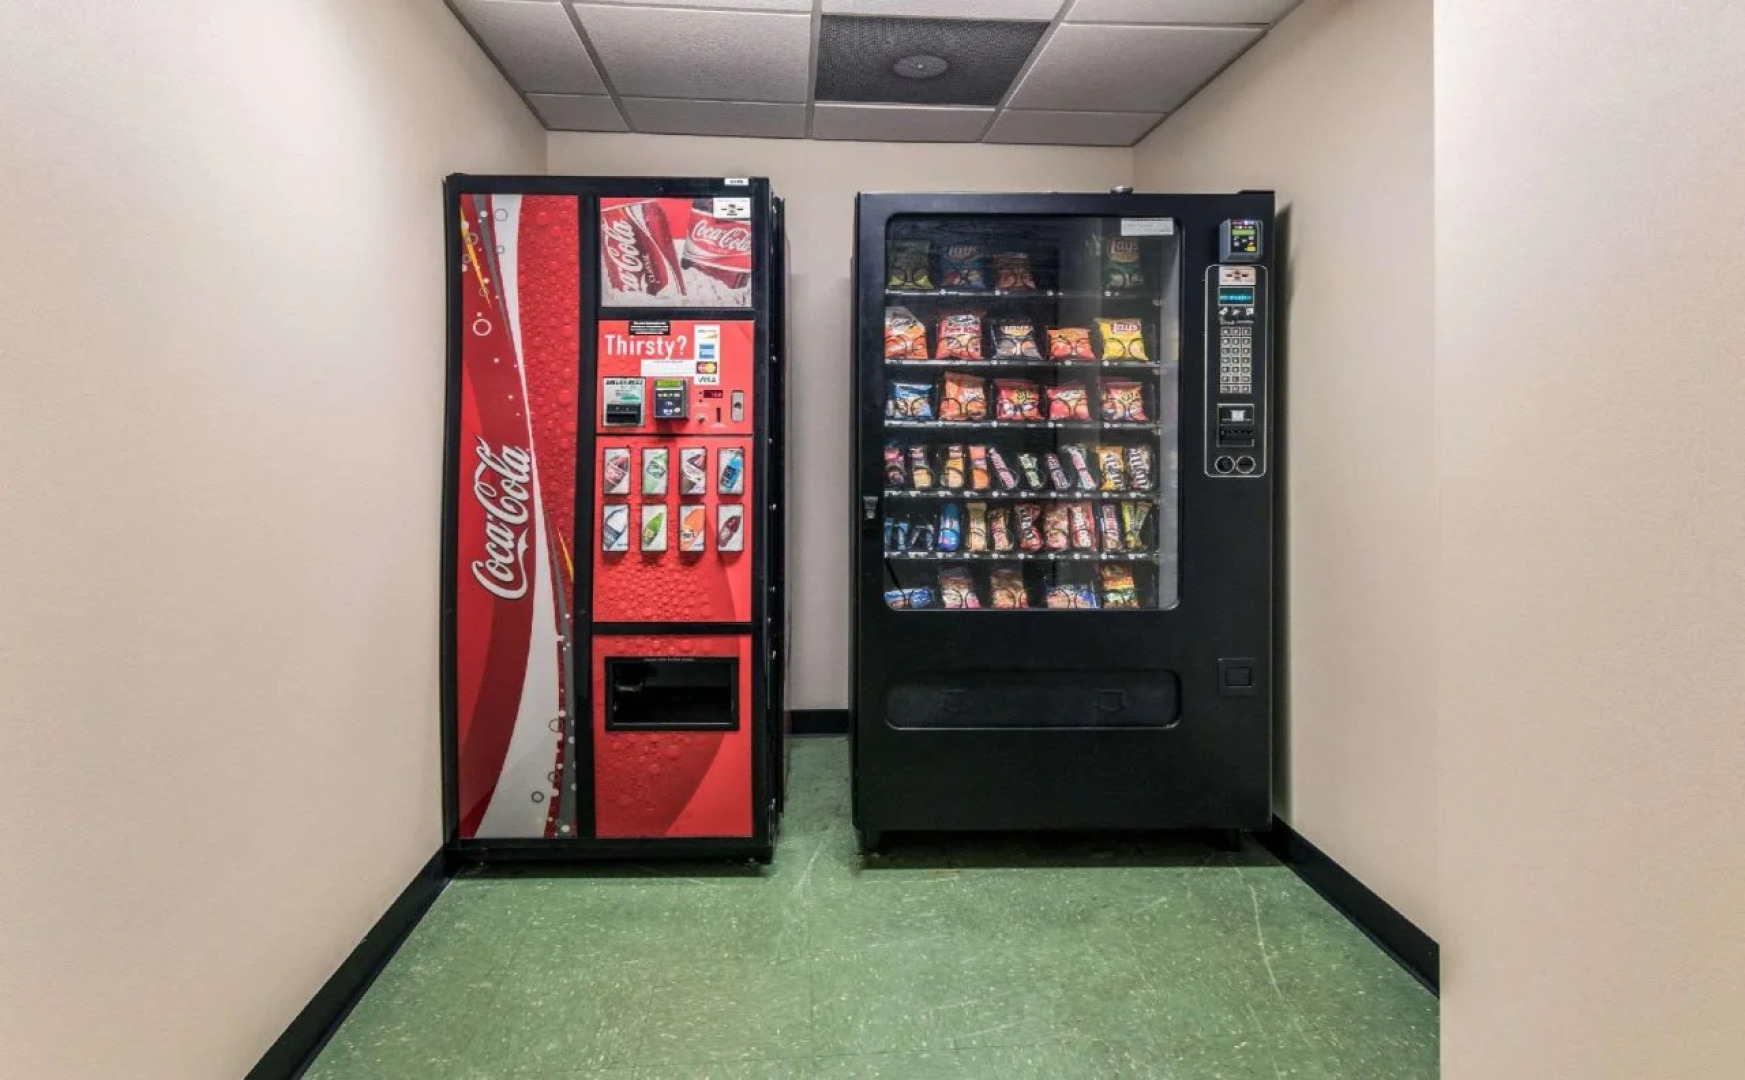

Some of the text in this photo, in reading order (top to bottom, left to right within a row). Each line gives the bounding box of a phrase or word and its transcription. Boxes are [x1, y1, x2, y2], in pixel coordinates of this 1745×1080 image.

[601, 217, 642, 292] ca-Cola
[604, 334, 688, 360] Thirsty?
[472, 435, 531, 600] Coca-Cola
